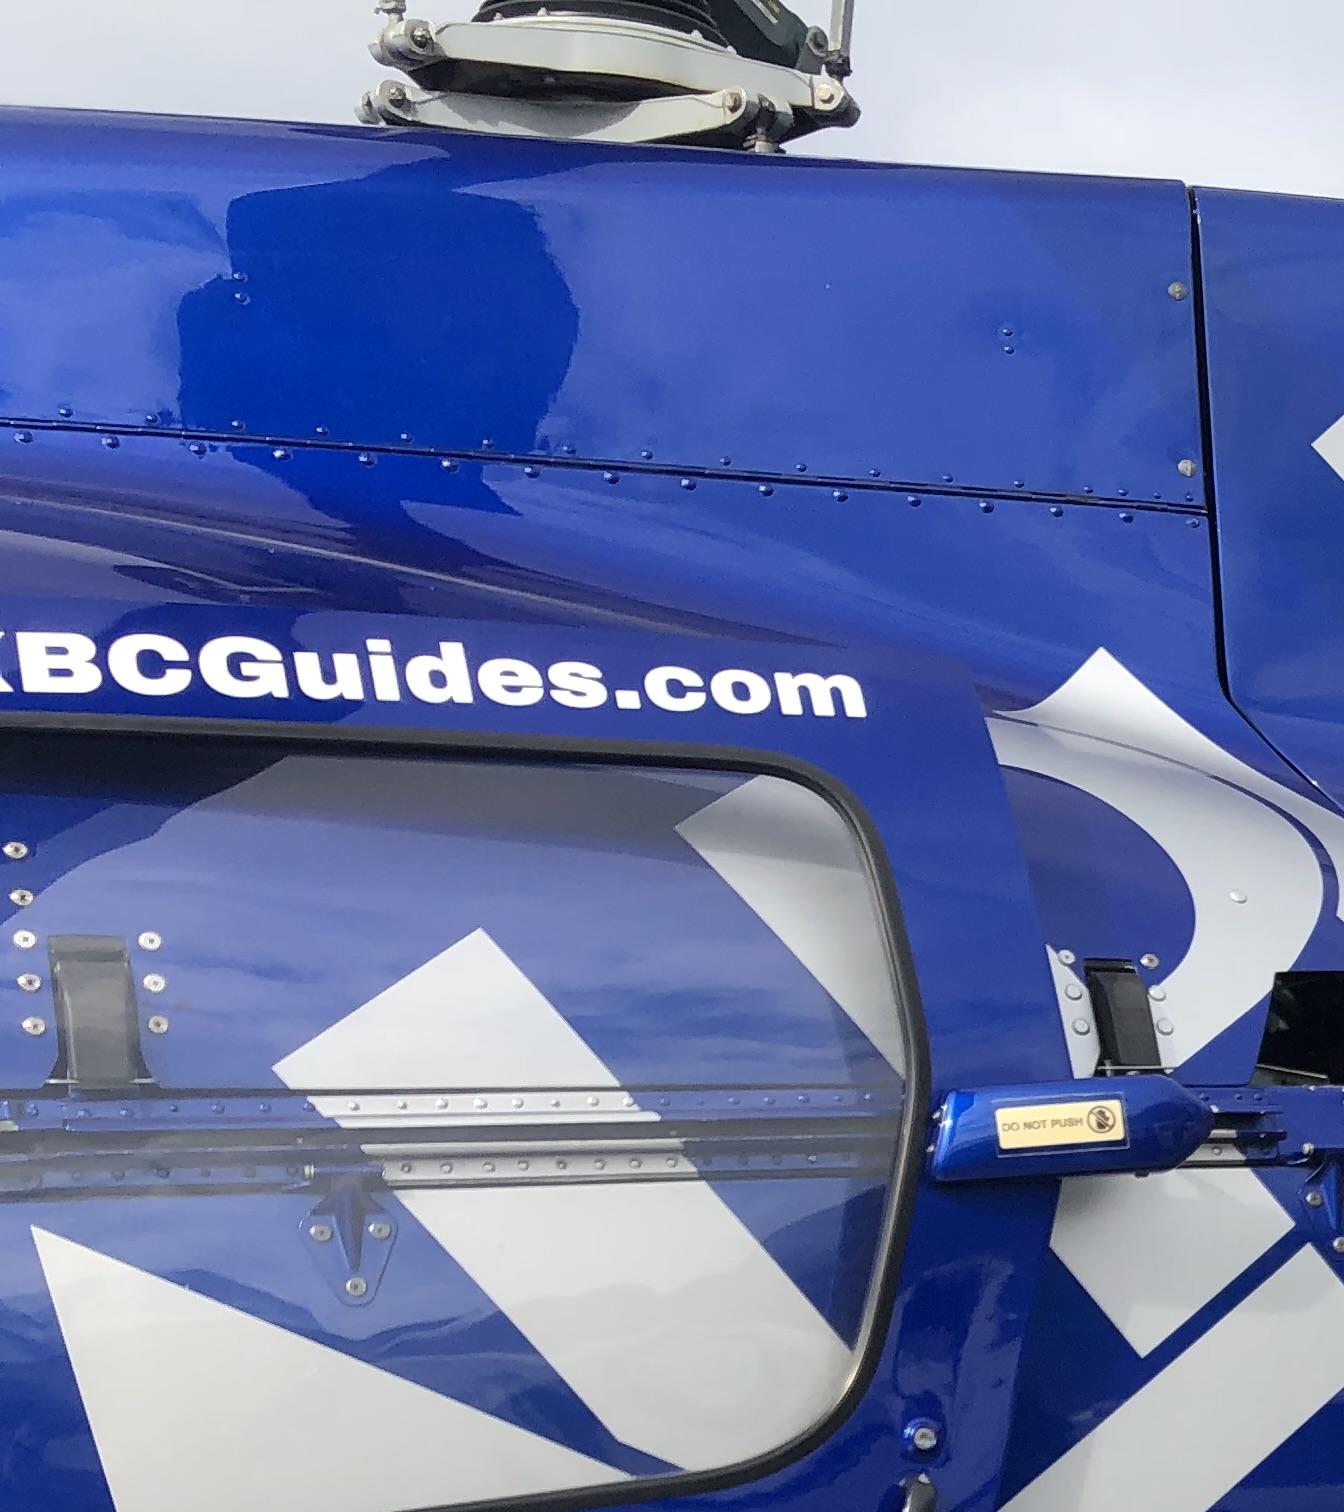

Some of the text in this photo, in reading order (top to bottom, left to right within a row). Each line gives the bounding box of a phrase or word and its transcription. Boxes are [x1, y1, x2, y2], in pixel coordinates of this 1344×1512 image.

[0, 631, 868, 718] BCGuides.com
[1002, 1117, 1084, 1132] DO NOT PUSH
